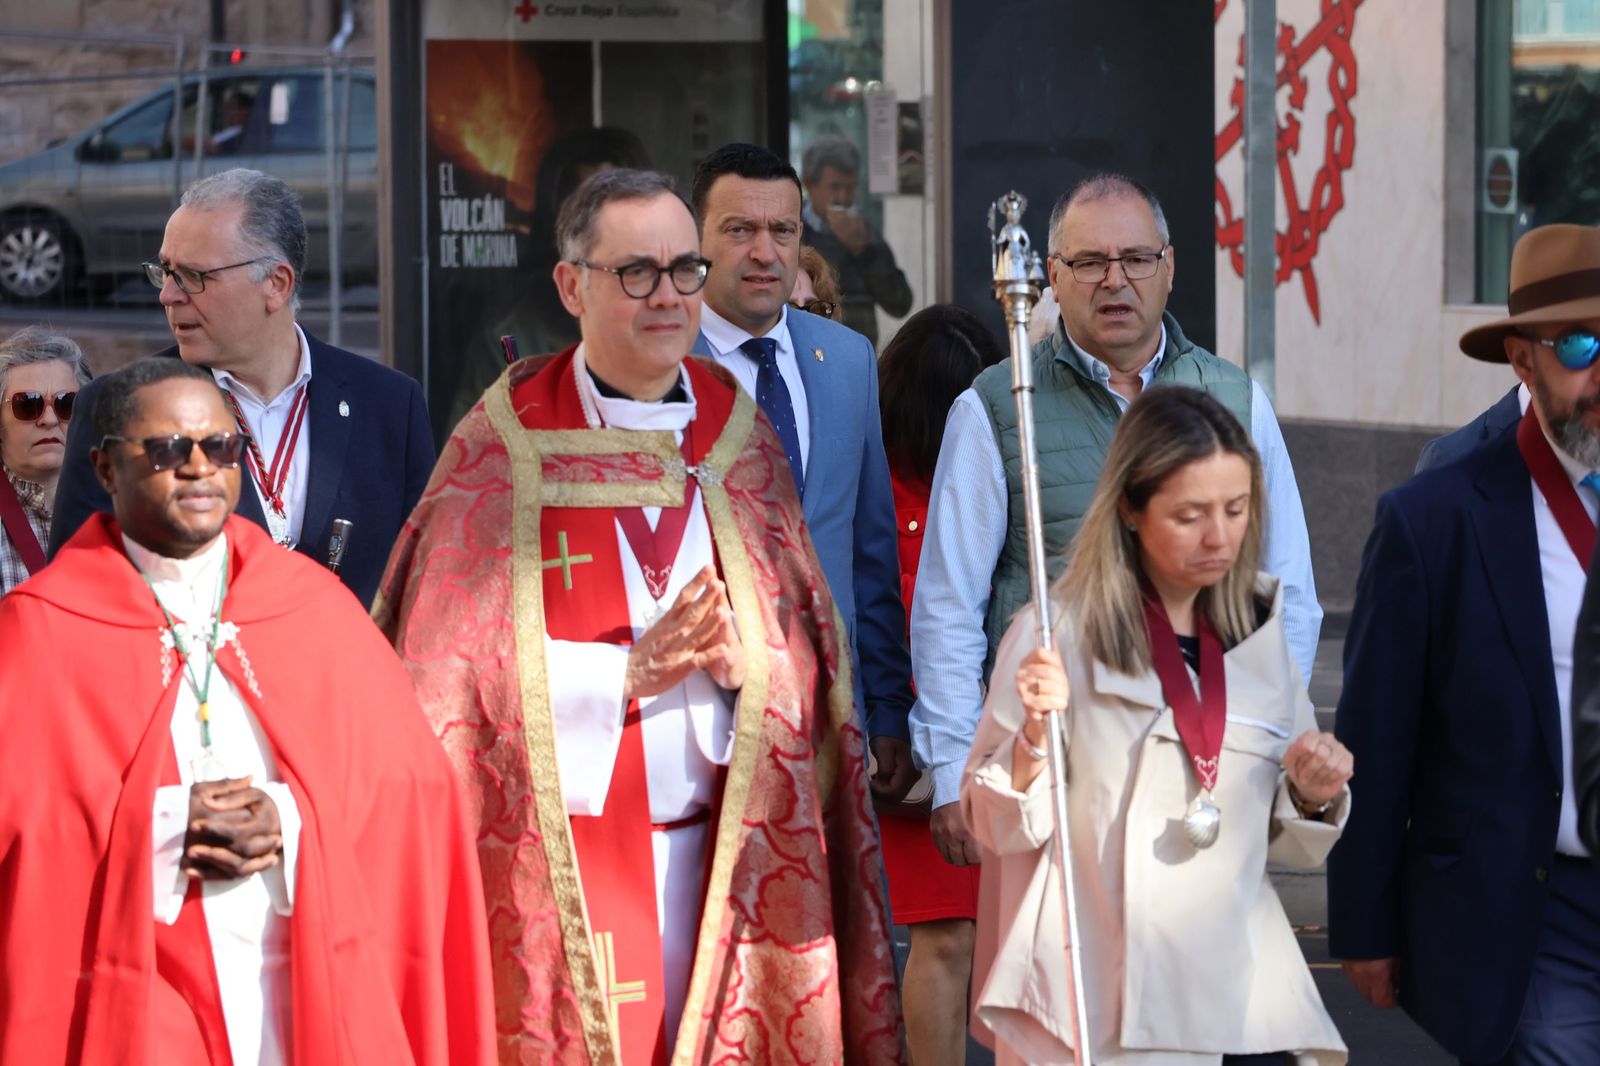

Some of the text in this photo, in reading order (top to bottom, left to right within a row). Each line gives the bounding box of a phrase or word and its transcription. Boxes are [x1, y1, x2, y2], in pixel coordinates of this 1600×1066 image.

[544, 4, 578, 18] Cruz
[580, 4, 614, 19] Roja
[438, 161, 457, 197] EL
[439, 192, 505, 233] VOLCÁN
[439, 234, 460, 268] DE
